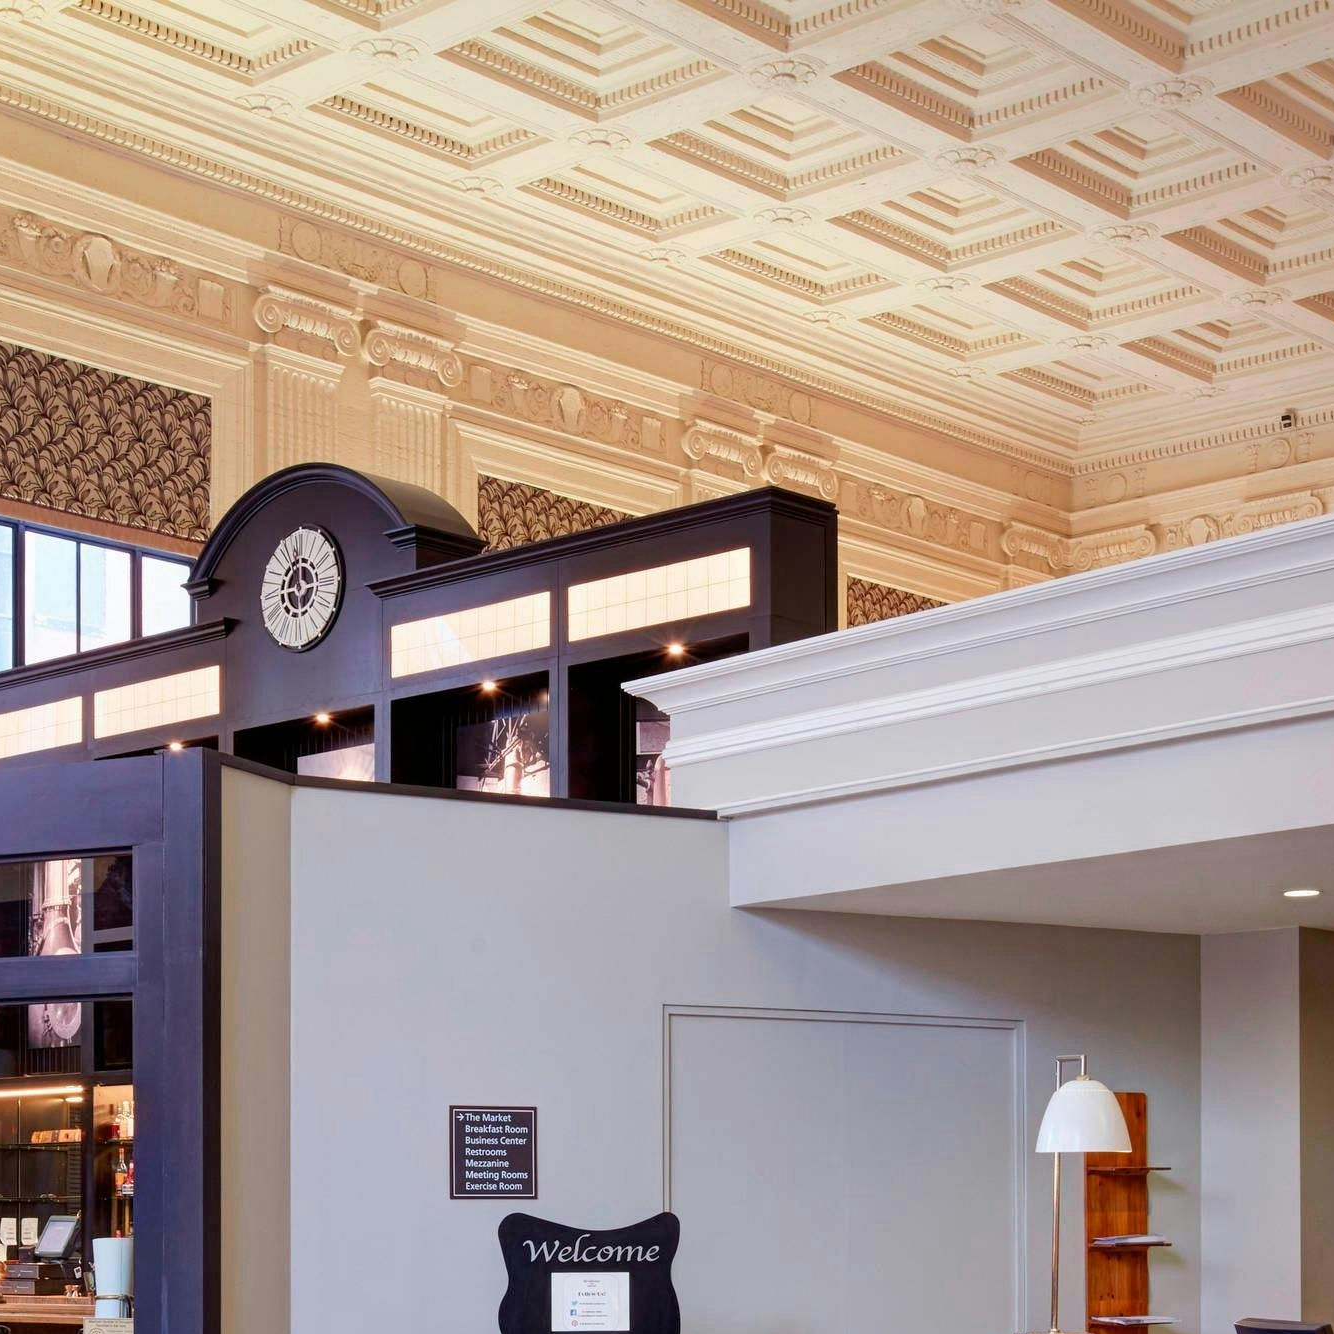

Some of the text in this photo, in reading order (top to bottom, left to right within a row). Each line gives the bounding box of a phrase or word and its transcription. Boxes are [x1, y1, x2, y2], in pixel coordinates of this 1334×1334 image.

[465, 1113, 511, 1122] The Market
[465, 1124, 528, 1134] Breakfast Room
[465, 1136, 527, 1145] Business Center
[465, 1147, 507, 1156] Restrooms
[465, 1159, 509, 1168] Mezzanine
[465, 1170, 528, 1180] Meeting Rooms
[465, 1182, 522, 1190] Exercise Room
[522, 1233, 660, 1263] Welcome
